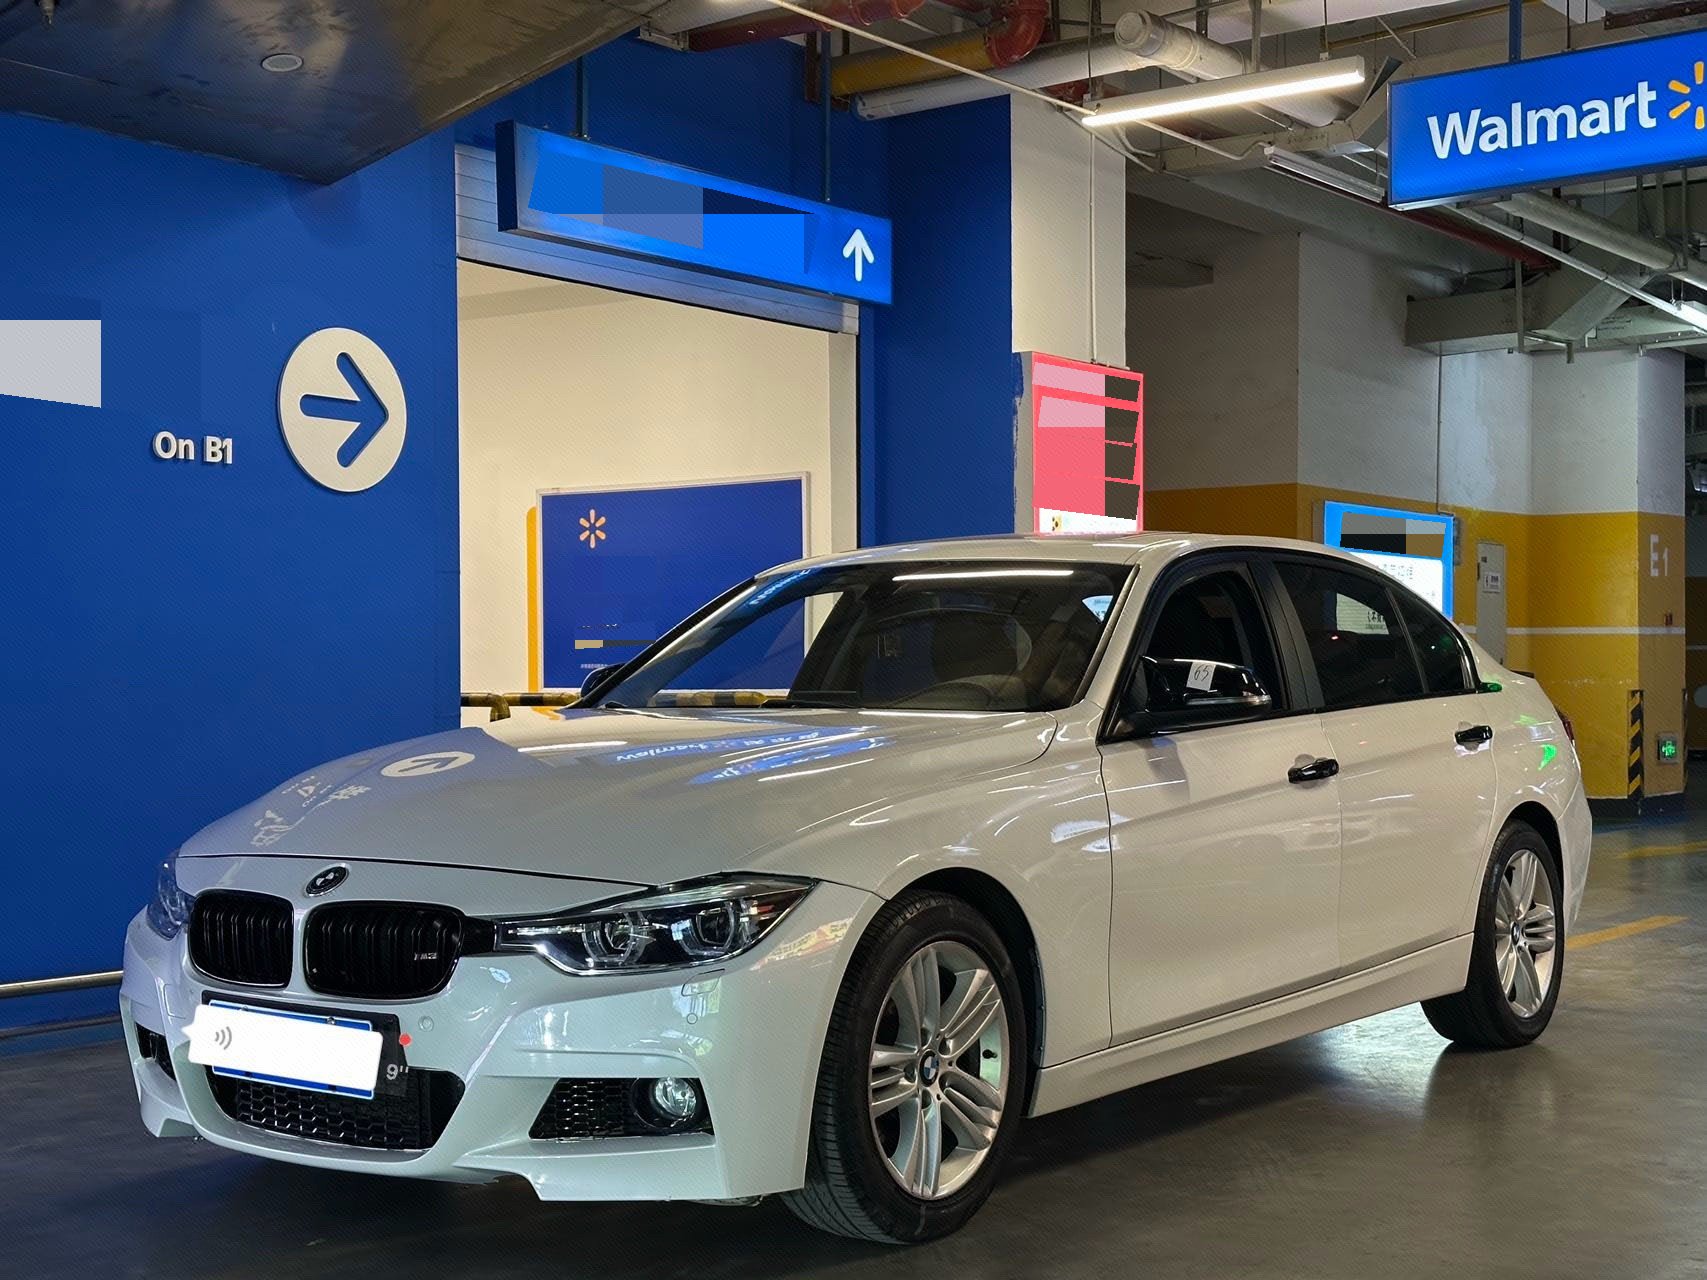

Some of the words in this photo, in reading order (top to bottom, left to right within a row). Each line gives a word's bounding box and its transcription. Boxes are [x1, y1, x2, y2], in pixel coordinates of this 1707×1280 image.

[1427, 81, 1656, 160] Walmart
[153, 431, 194, 460] On
[204, 435, 232, 464] B1
[1650, 533, 1668, 577] E1
